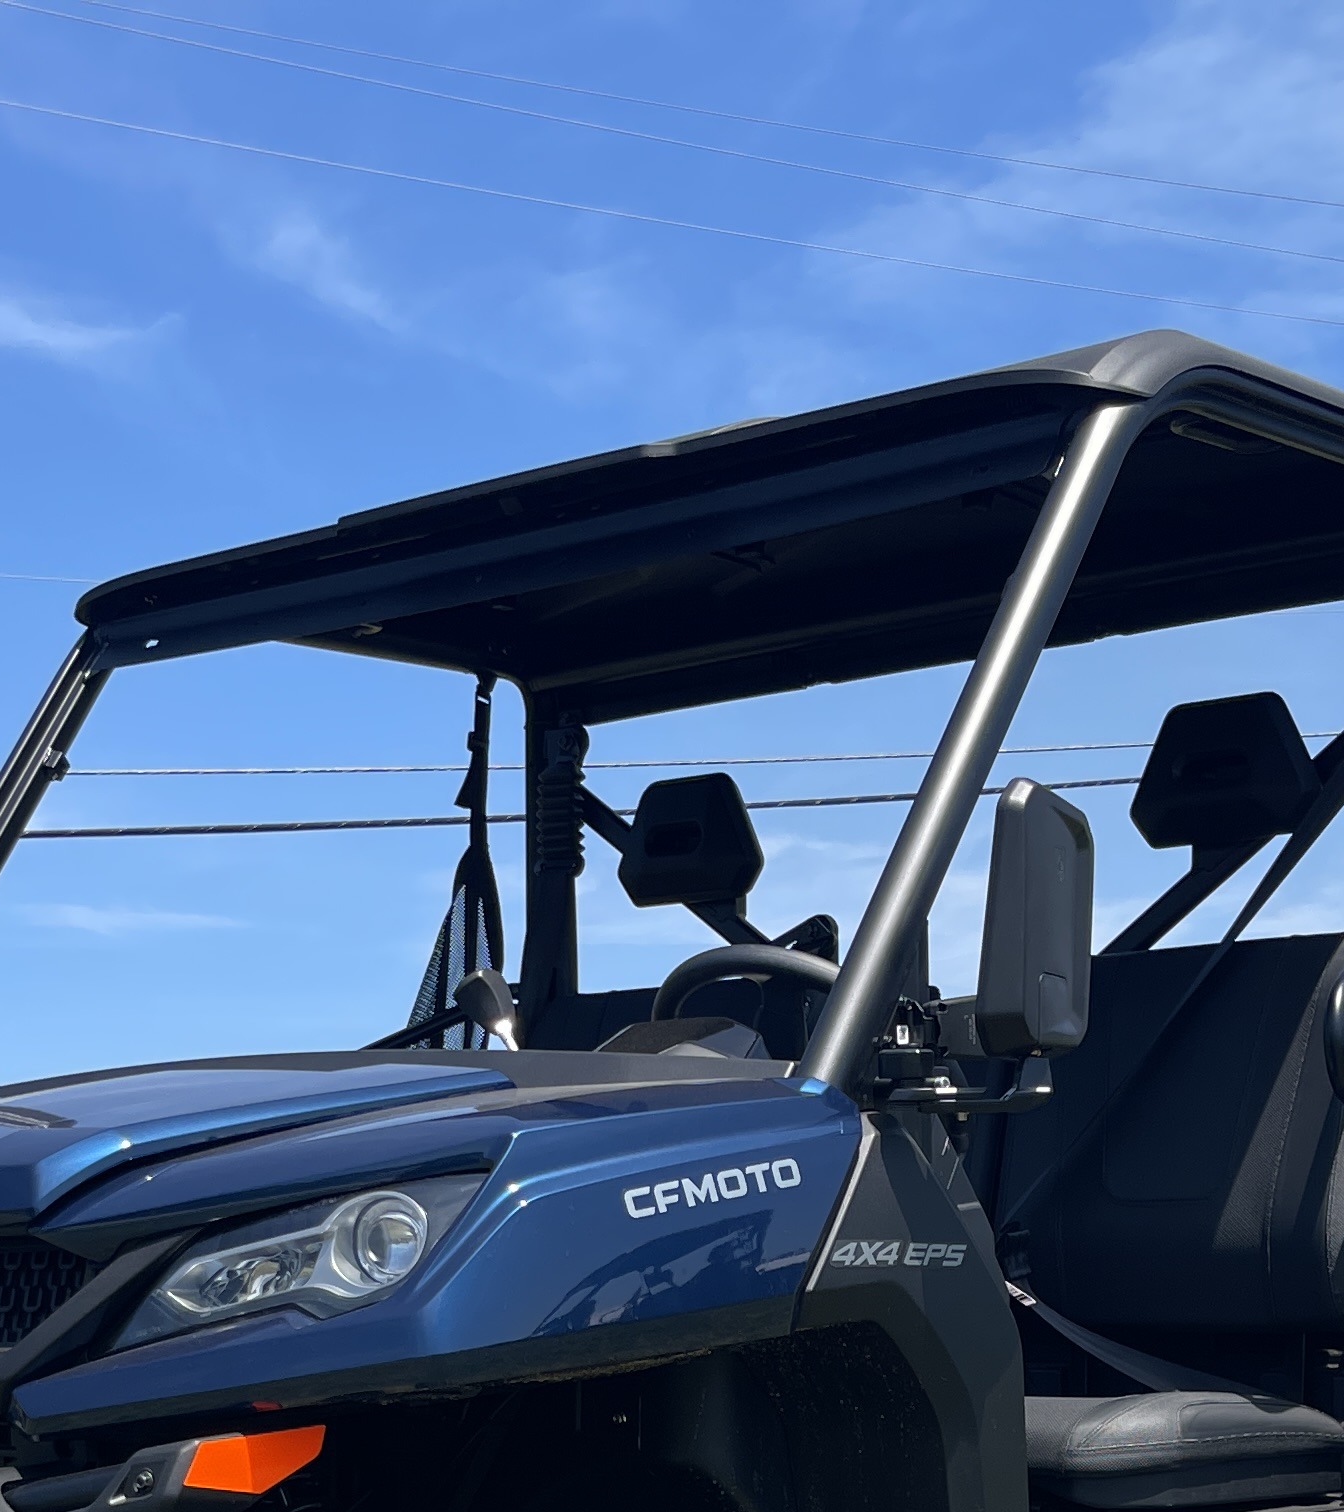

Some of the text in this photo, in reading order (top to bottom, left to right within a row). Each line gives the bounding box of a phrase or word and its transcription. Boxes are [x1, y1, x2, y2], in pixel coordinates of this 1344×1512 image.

[623, 1157, 802, 1219] CFMOTO
[831, 1241, 968, 1267] 4X4 EPS
